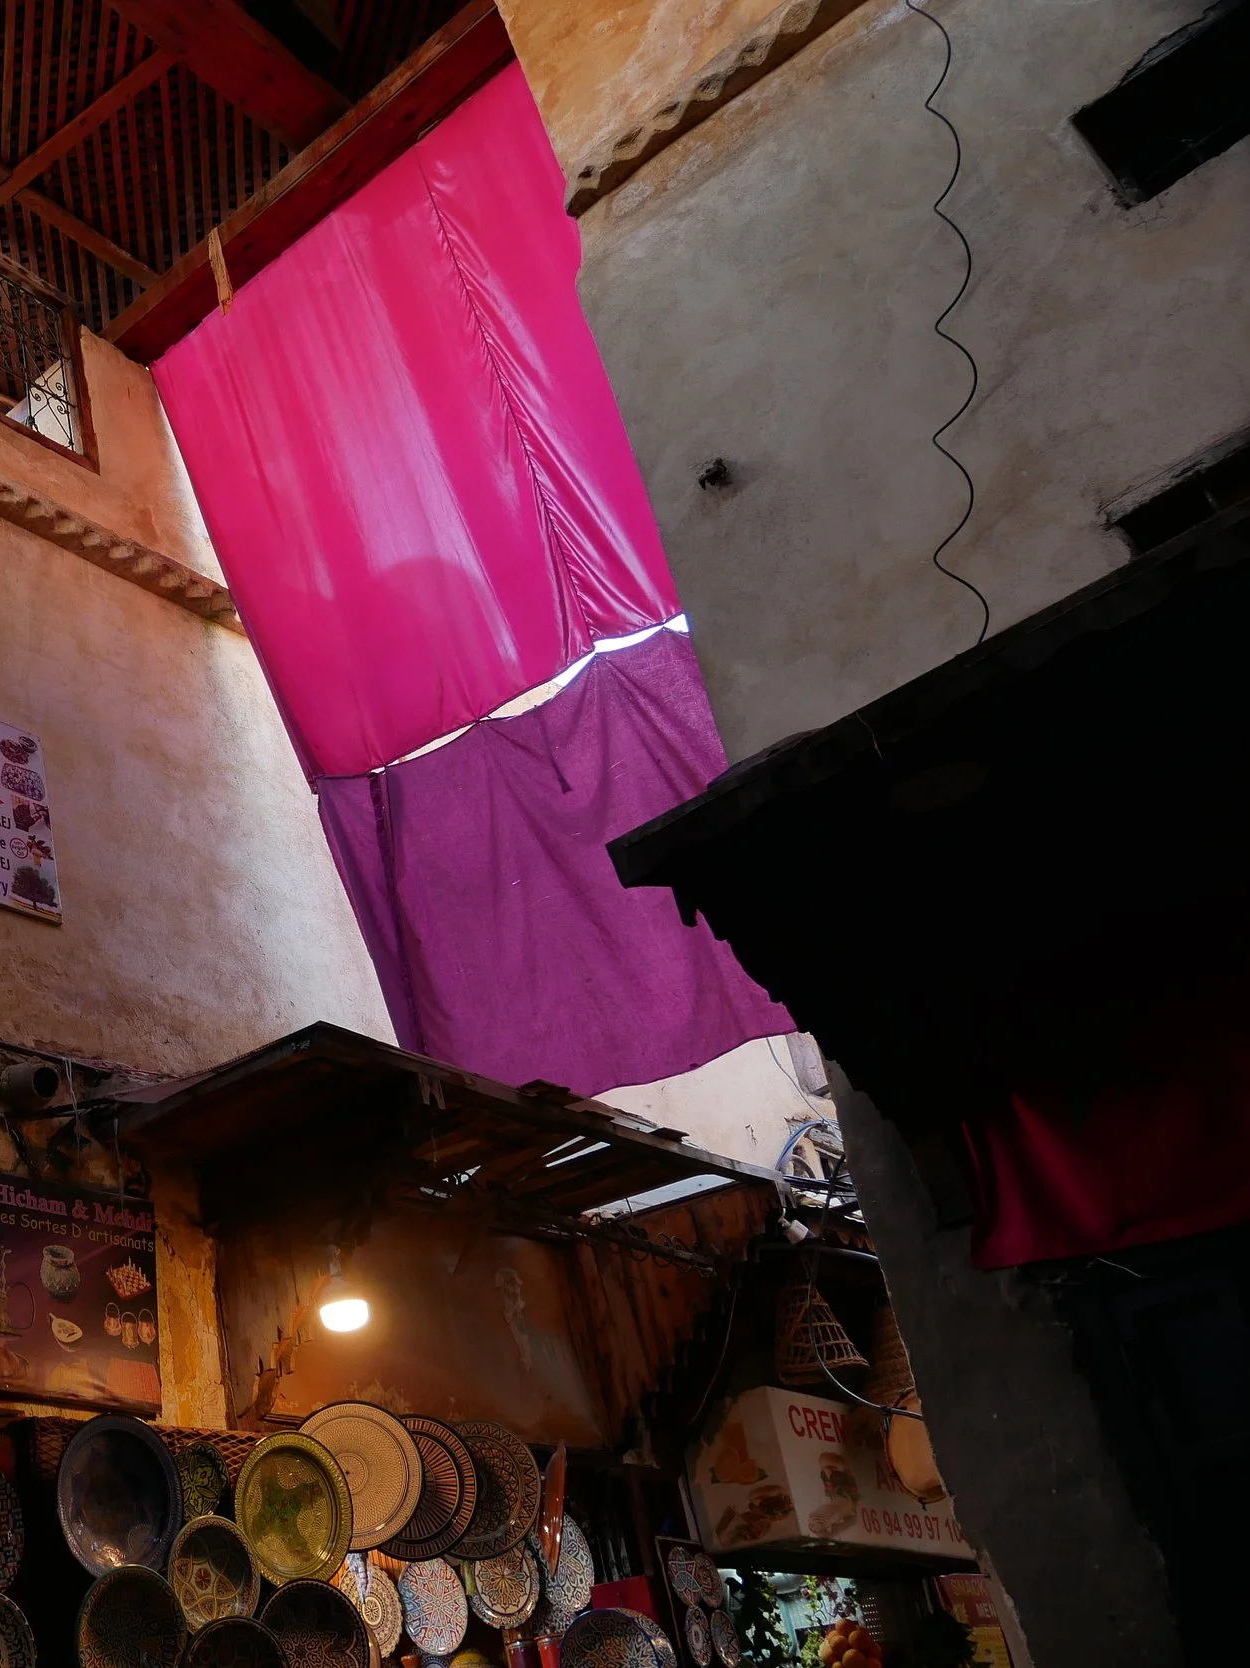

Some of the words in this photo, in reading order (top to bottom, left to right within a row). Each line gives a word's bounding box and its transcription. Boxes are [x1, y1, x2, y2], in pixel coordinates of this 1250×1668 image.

[20, 1213, 67, 1235] Sortes
[71, 1198, 91, 1221] &
[93, 1201, 154, 1233] Mehdi
[788, 1404, 848, 1444] CREM
[861, 1507, 882, 1534] 06
[883, 1510, 903, 1536] 94
[904, 1512, 923, 1538] 99
[924, 1515, 941, 1541] 97
[975, 1602, 998, 1618] MEN
